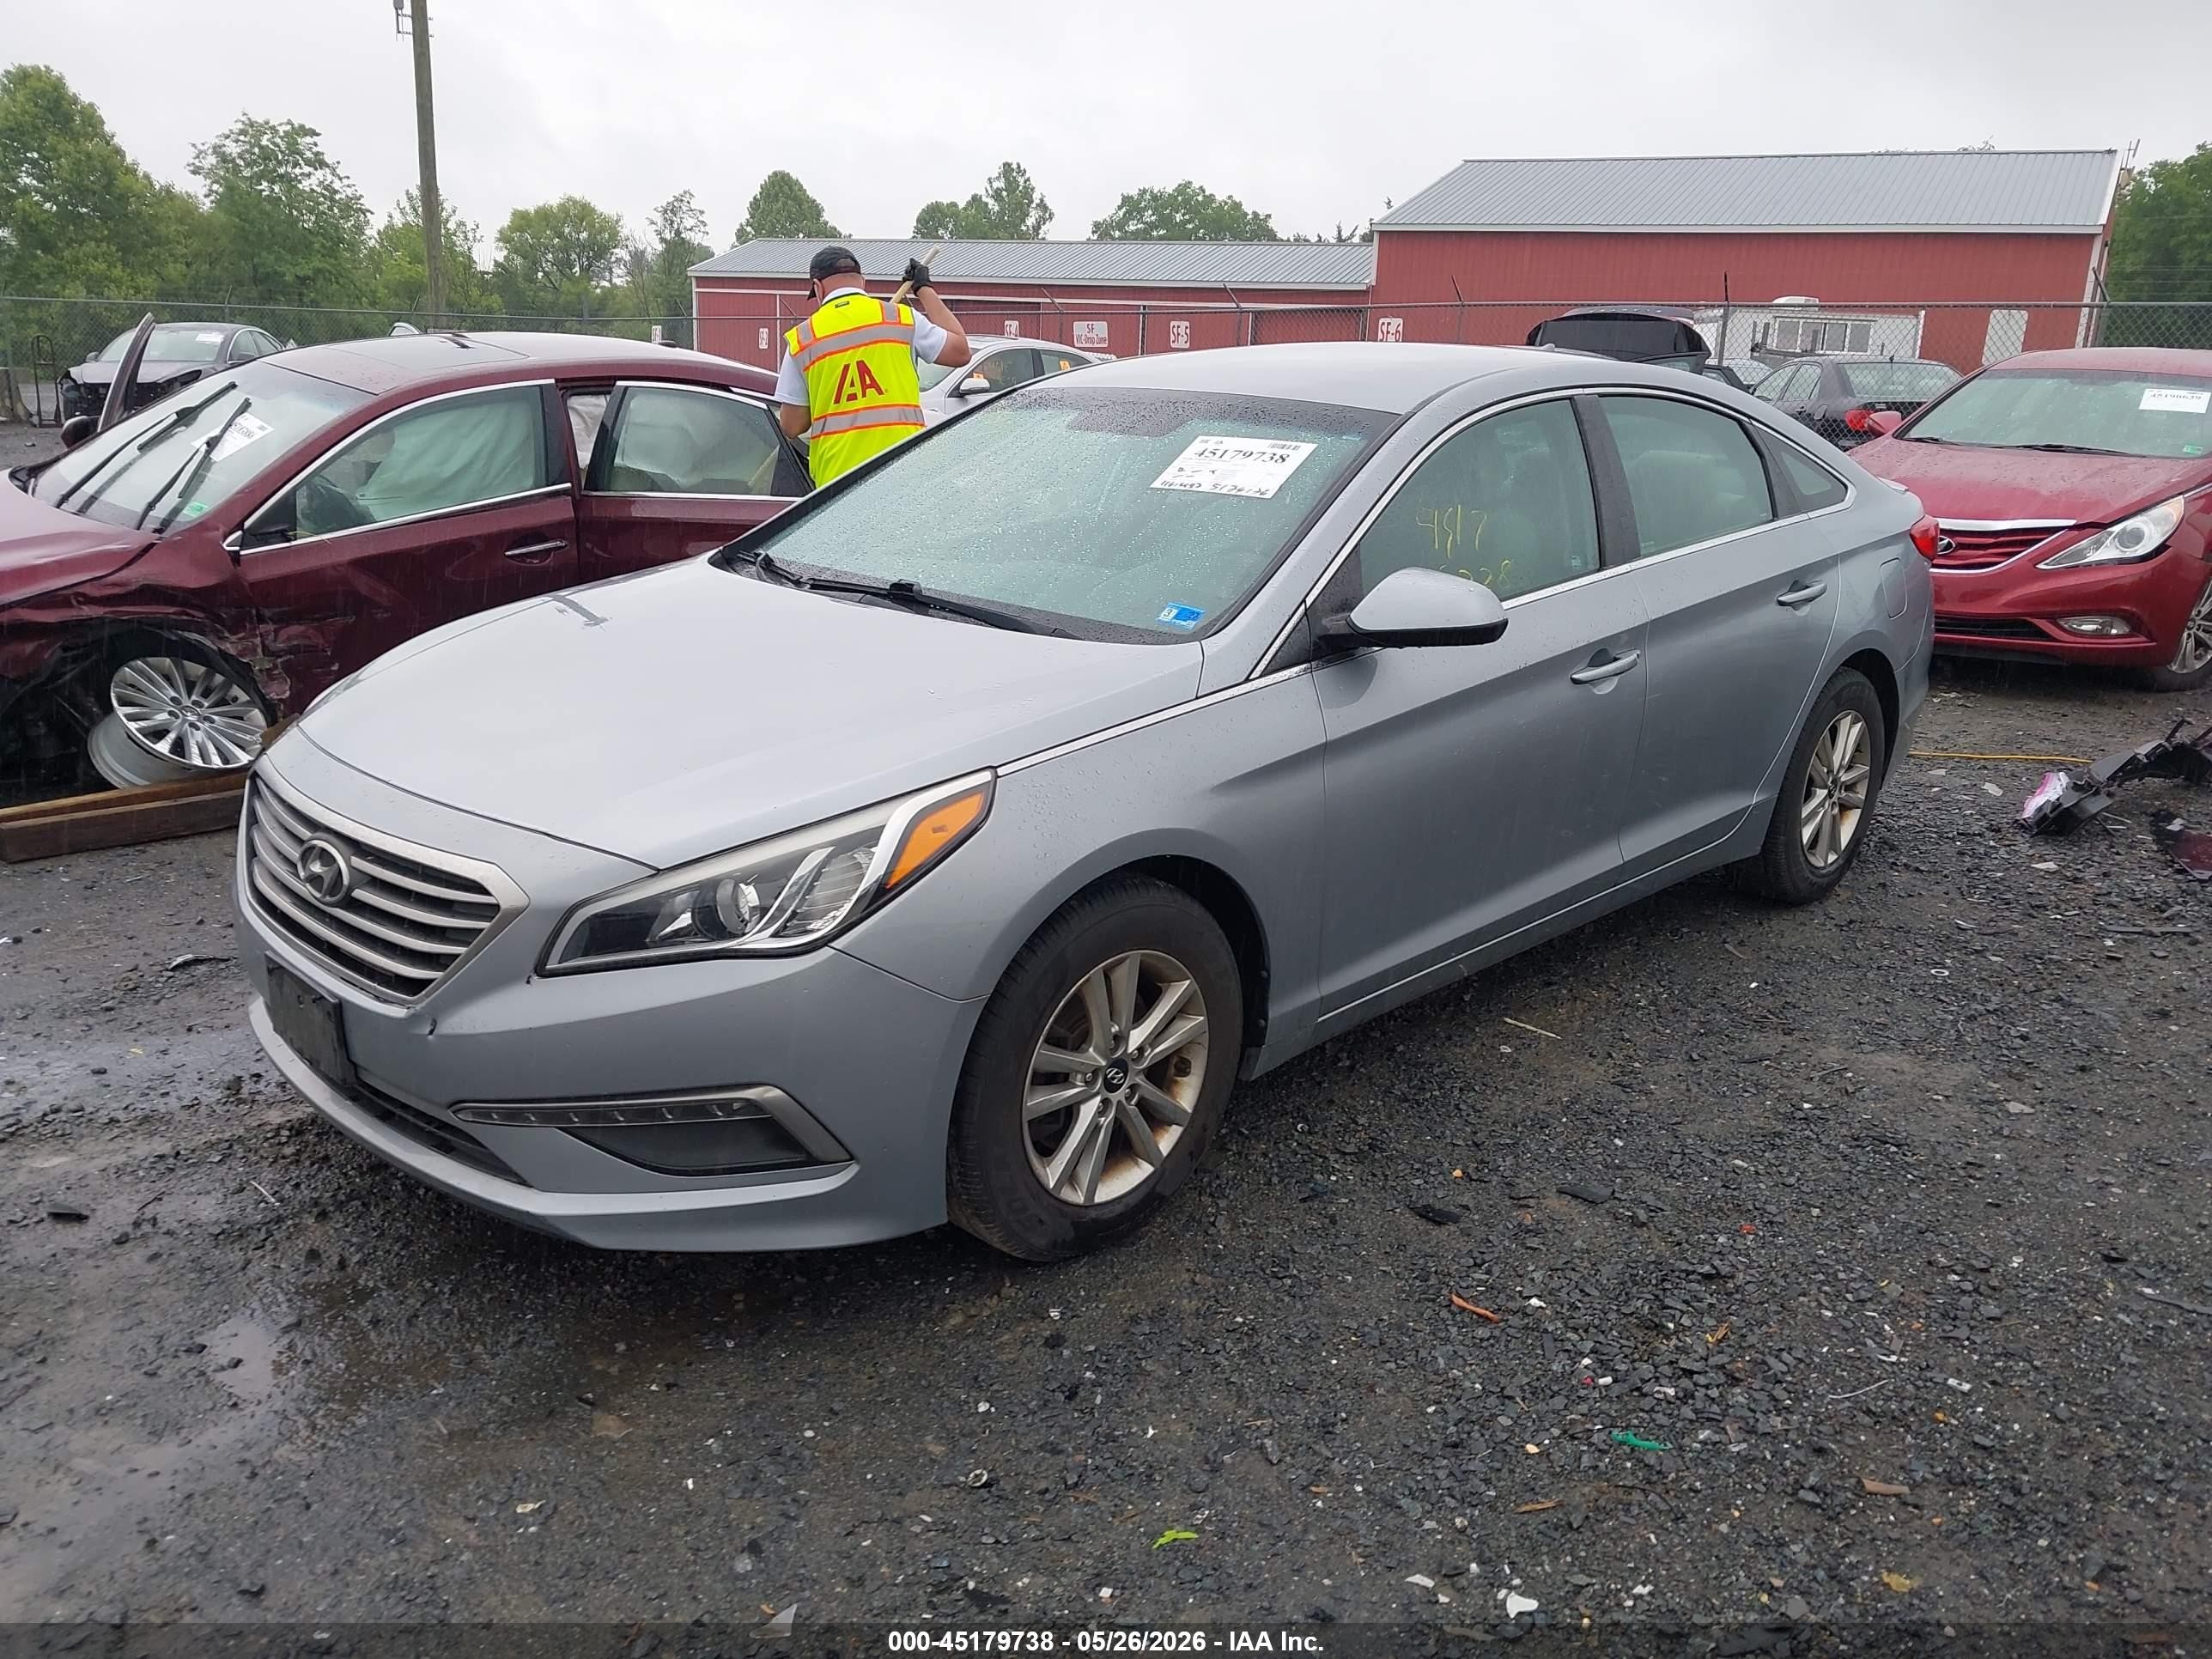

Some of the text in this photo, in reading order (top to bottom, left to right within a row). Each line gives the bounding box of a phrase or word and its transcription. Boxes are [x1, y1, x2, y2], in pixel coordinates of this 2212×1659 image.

[1087, 324, 1095, 333] SF
[1172, 325, 1188, 343] SF-5
[1380, 322, 1401, 342] SF-6
[1096, 334, 1107, 343] Zone
[1194, 447, 1290, 464] 45179738
